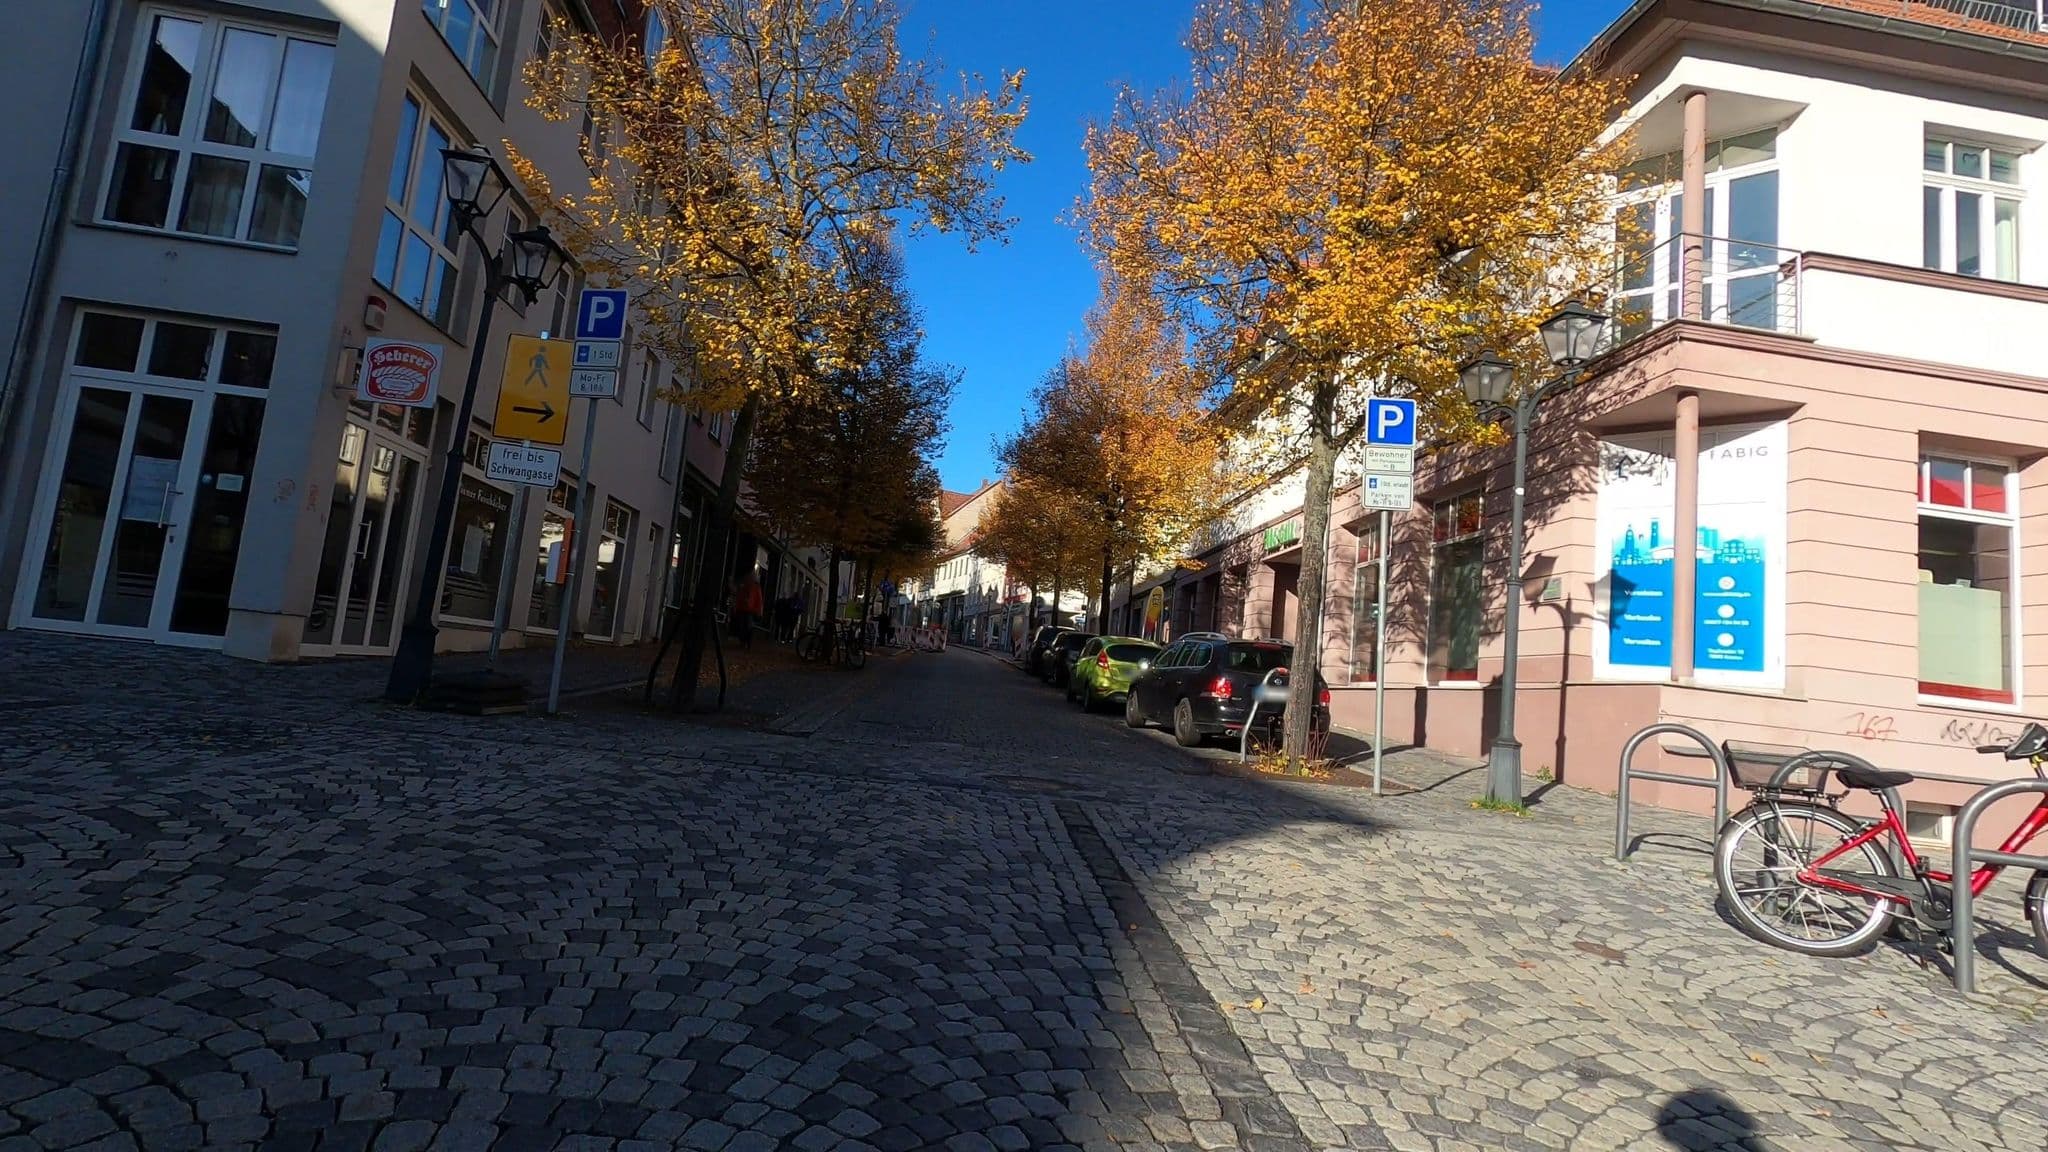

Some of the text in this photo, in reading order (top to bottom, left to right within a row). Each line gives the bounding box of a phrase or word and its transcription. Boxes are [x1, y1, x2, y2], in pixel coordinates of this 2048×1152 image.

[586, 296, 615, 332] P
[1377, 404, 1405, 439] P
[502, 448, 545, 464] frei bis
[1368, 450, 1409, 459] Bewohner
[490, 462, 554, 481] Schwangasse
